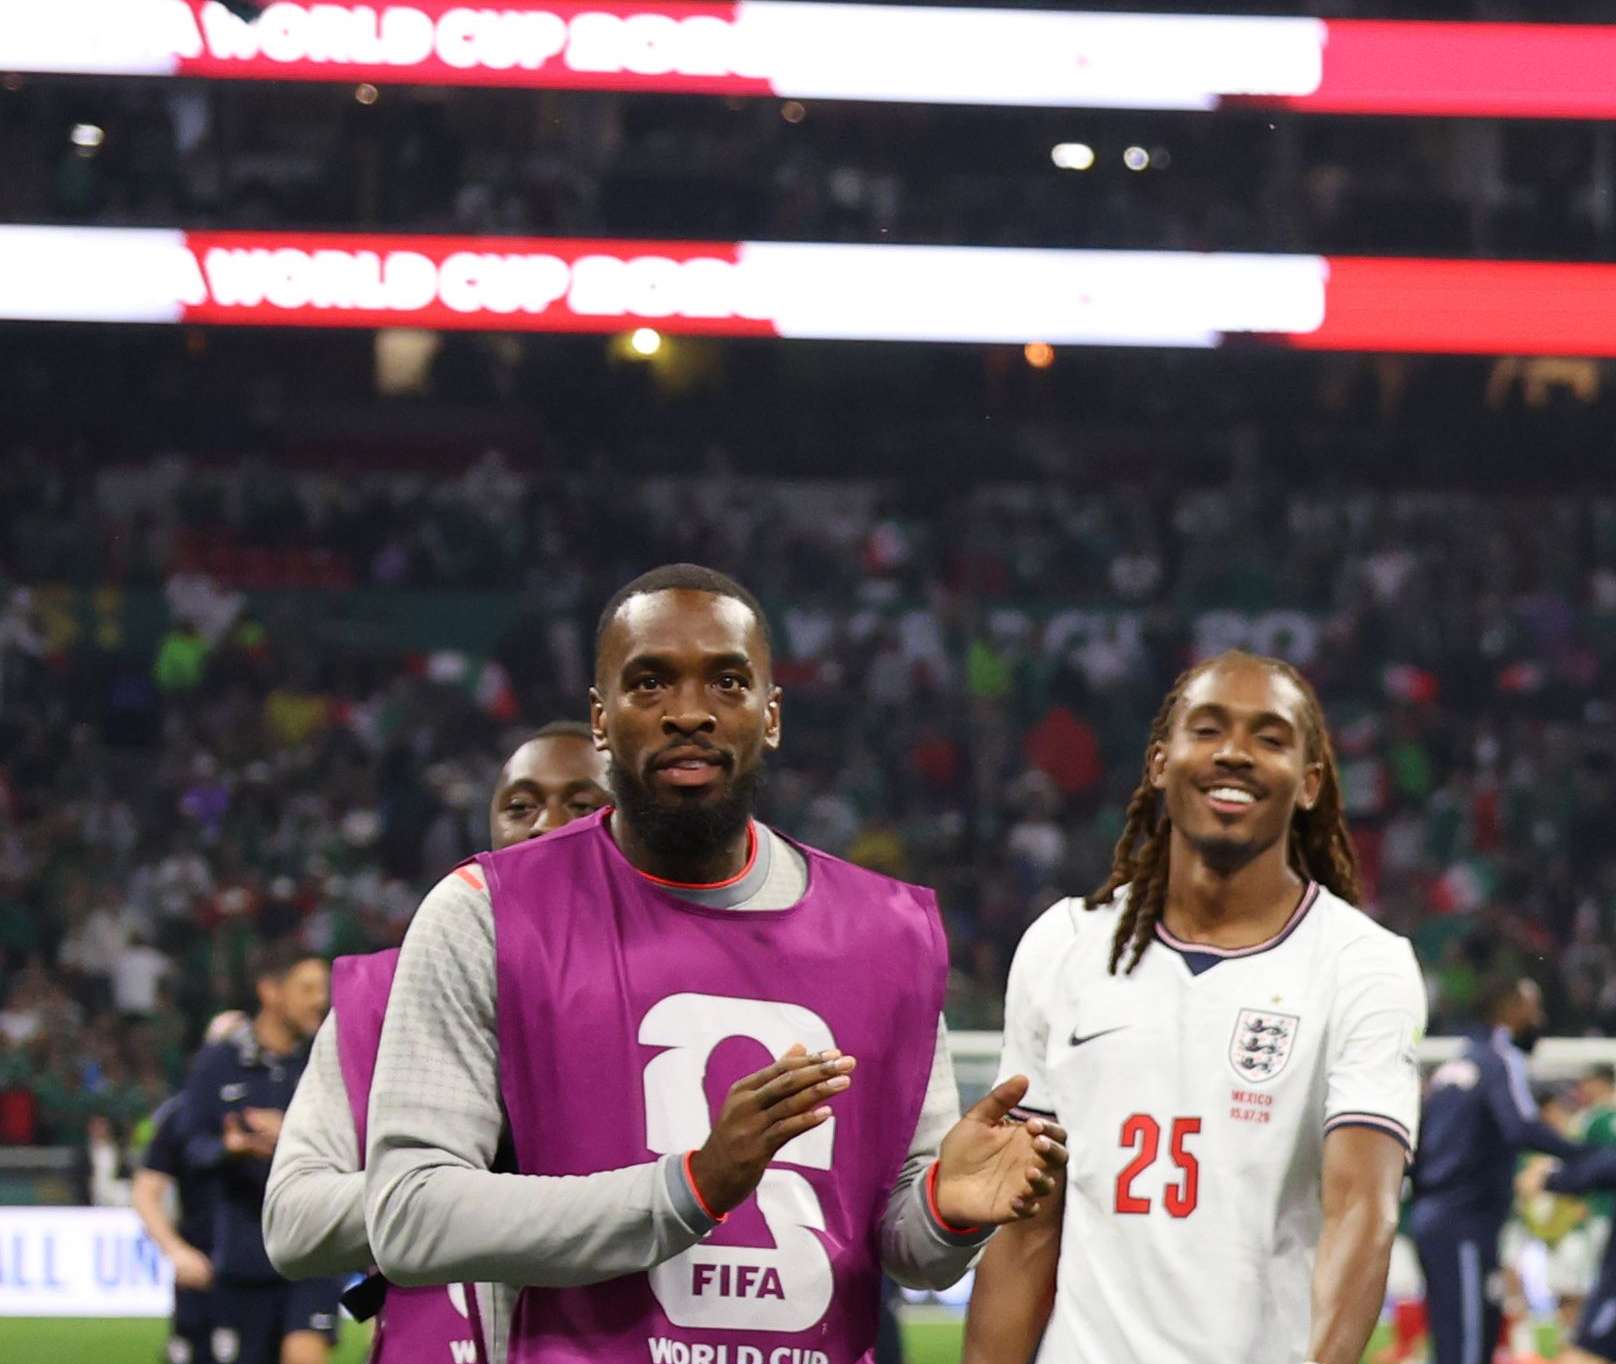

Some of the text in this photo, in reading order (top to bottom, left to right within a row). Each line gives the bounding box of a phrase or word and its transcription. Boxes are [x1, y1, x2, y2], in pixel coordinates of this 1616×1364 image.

[435, 8, 567, 68] CUP
[204, 248, 437, 310] WORLD
[438, 251, 570, 313] CUP
[1114, 1112, 1202, 1218] 25
[691, 1263, 786, 1300] FIFA
